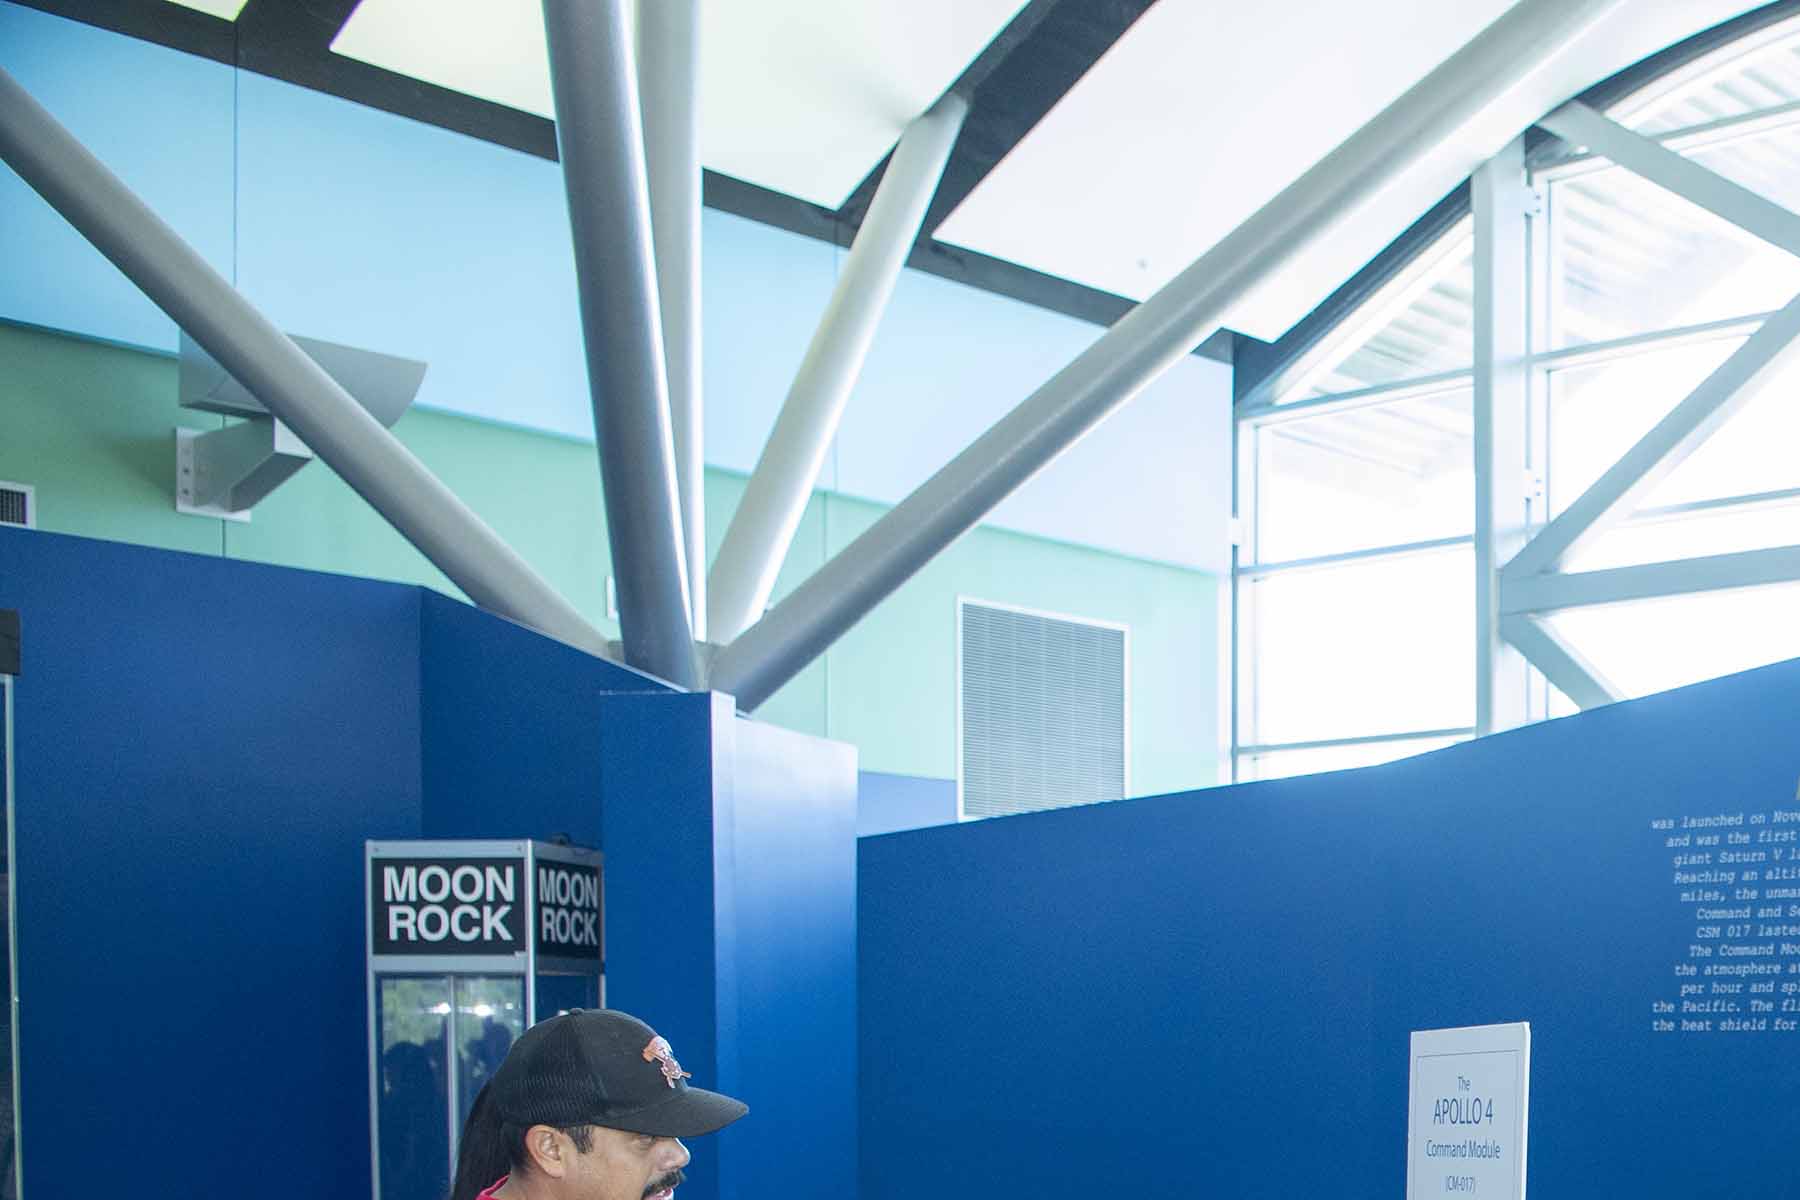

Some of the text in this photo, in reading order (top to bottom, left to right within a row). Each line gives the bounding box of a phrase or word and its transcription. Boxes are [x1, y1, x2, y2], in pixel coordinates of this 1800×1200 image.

[1651, 819, 1674, 829] was
[1682, 816, 1743, 827] launched
[1750, 815, 1765, 824] on
[1666, 836, 1689, 847] and
[1696, 836, 1719, 846] was
[1727, 832, 1750, 844] the
[1758, 830, 1797, 843] first
[1674, 854, 1712, 867] giant
[1720, 852, 1766, 863] Saturn
[1774, 850, 1782, 860] V
[384, 866, 514, 903] MOON
[1674, 872, 1734, 885] Reaching
[1742, 870, 1758, 880] an
[539, 868, 598, 909] MOON
[1681, 892, 1725, 902] miles,
[1736, 888, 1757, 900] the
[1696, 908, 1751, 920] Command
[1758, 906, 1781, 918] and
[388, 905, 513, 942] ROCK
[542, 907, 597, 945] ROCK
[1696, 927, 1720, 938] CSM
[1727, 926, 1750, 937] 017
[1689, 946, 1712, 957] The
[1719, 944, 1774, 956] Command
[1675, 964, 1697, 976] the
[1704, 963, 1781, 977] atmosphere
[1681, 983, 1704, 996] per
[1712, 982, 1743, 993] hour
[1750, 981, 1774, 993] and
[1653, 1001, 1674, 1013] the
[1682, 1000, 1741, 1012] Pacific.
[1751, 1001, 1773, 1011] The
[1653, 1019, 1674, 1031] the
[1682, 1019, 1712, 1031] heat
[1720, 1018, 1766, 1030] shield
[1774, 1018, 1797, 1030] for
[1458, 1076, 1470, 1091] The
[1433, 1098, 1493, 1125] APOLLO 4
[1426, 1140, 1500, 1159] Command Module
